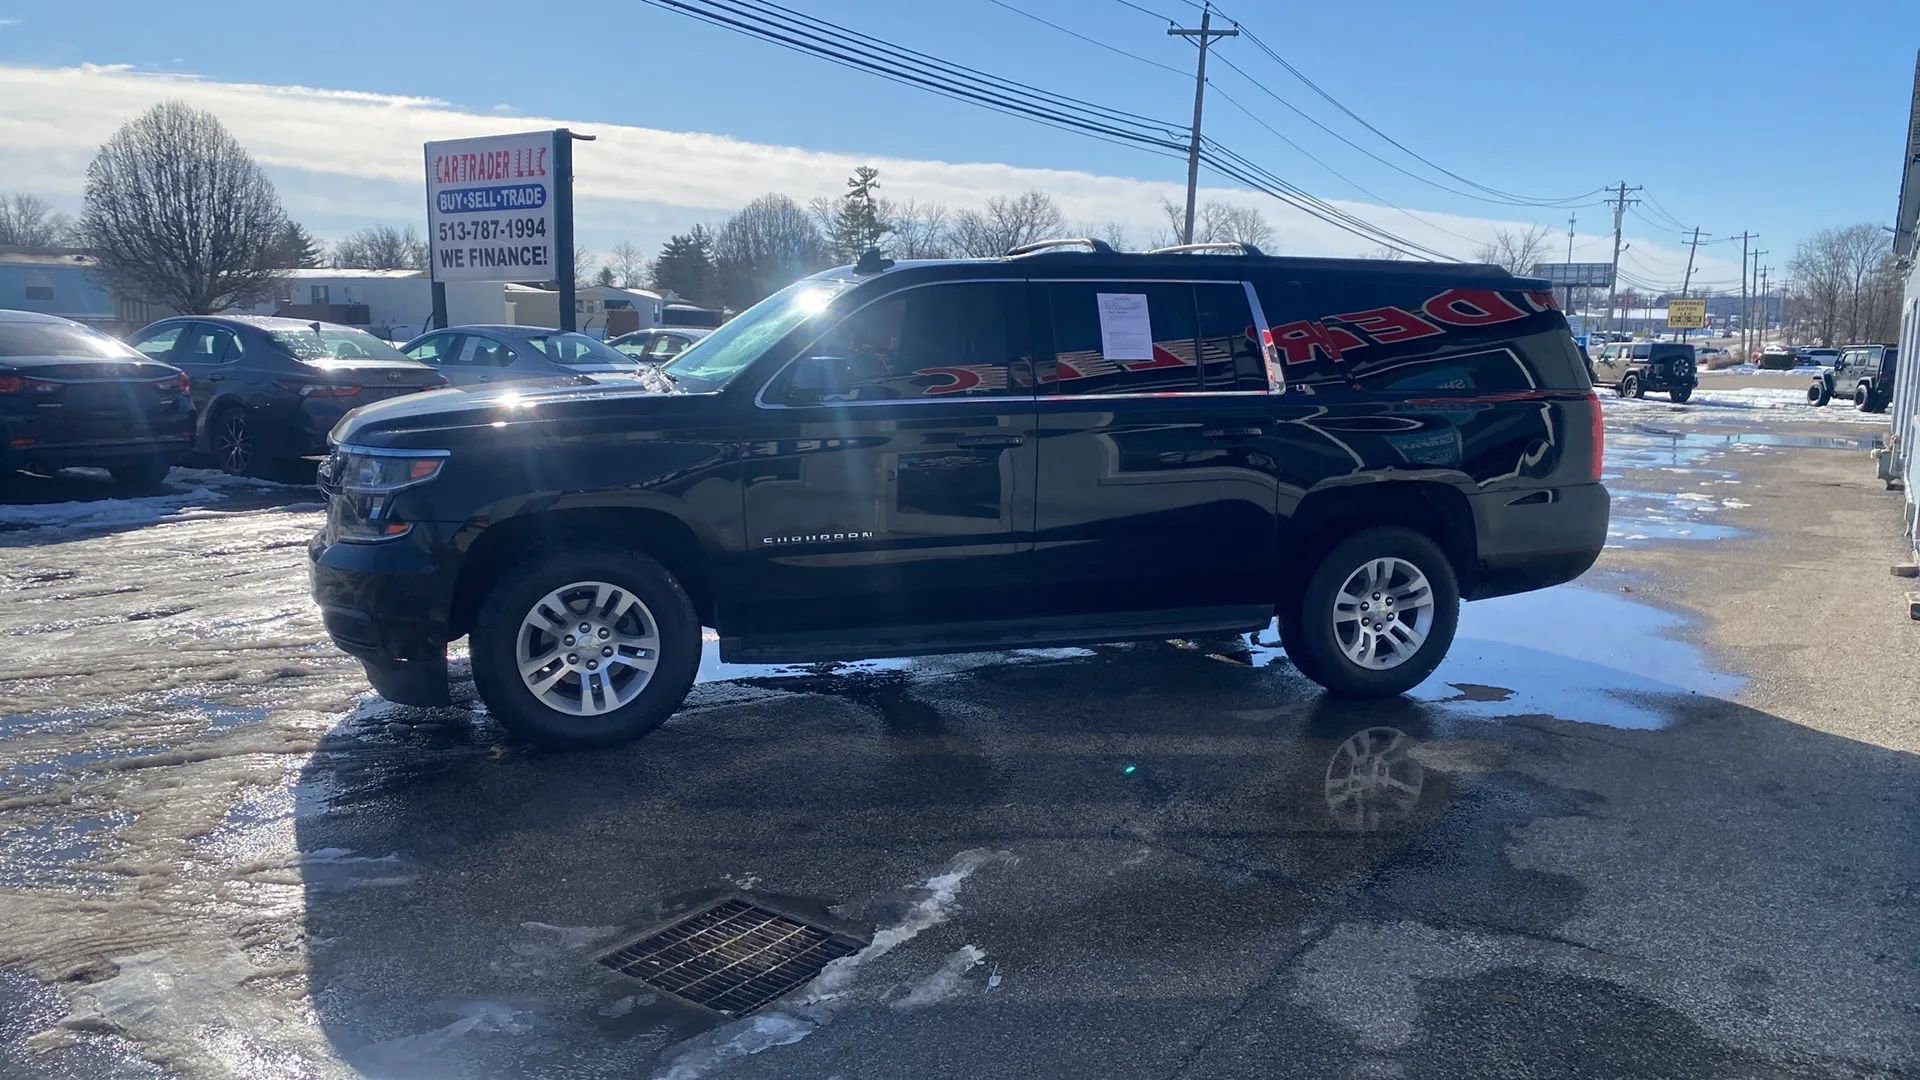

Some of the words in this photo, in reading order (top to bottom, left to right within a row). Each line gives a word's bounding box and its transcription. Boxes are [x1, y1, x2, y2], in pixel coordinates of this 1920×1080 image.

[516, 148, 546, 177] LLC
[439, 217, 546, 241] 513-787-1994
[440, 249, 465, 268] WE
[469, 246, 548, 267] FINANCE!
[763, 531, 873, 544] SUBURBAN
